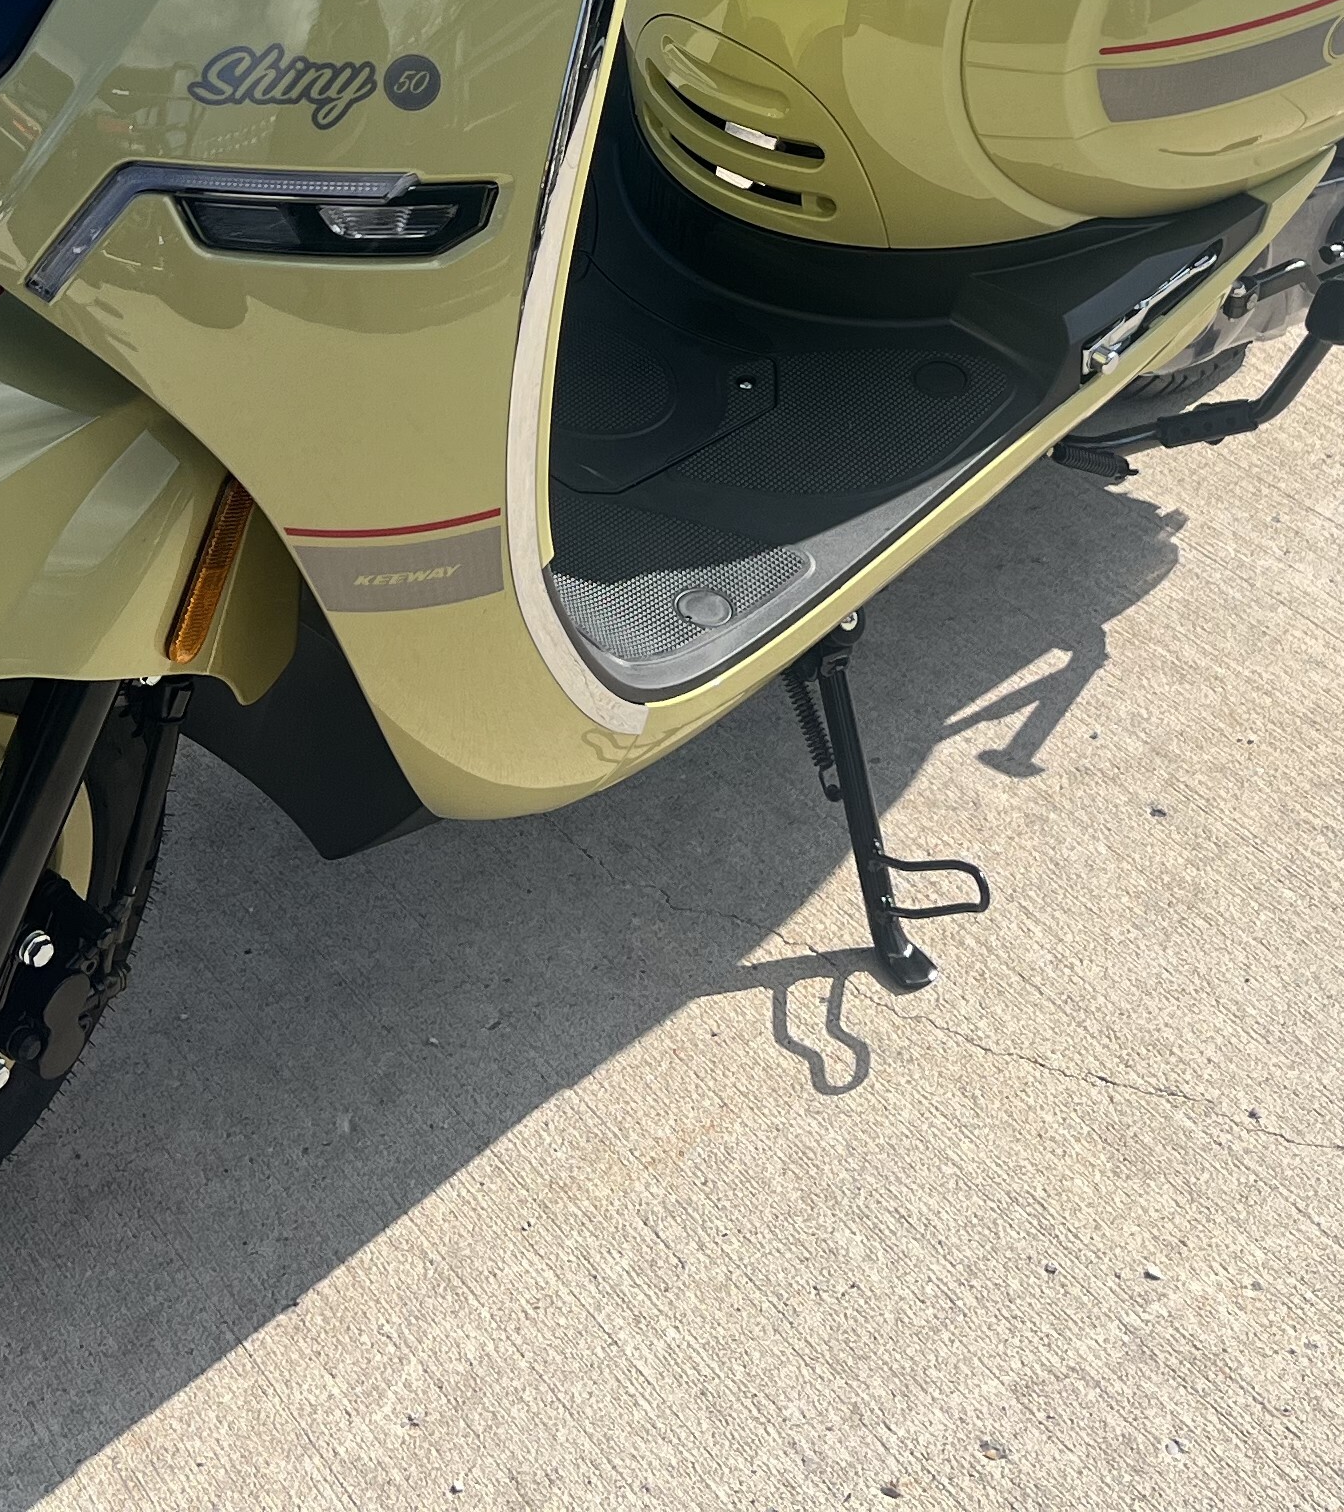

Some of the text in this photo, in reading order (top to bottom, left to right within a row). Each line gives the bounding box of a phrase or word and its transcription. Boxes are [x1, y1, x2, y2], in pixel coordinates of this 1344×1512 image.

[187, 42, 430, 131] Shiny 50
[353, 563, 462, 586] KEEWAY
